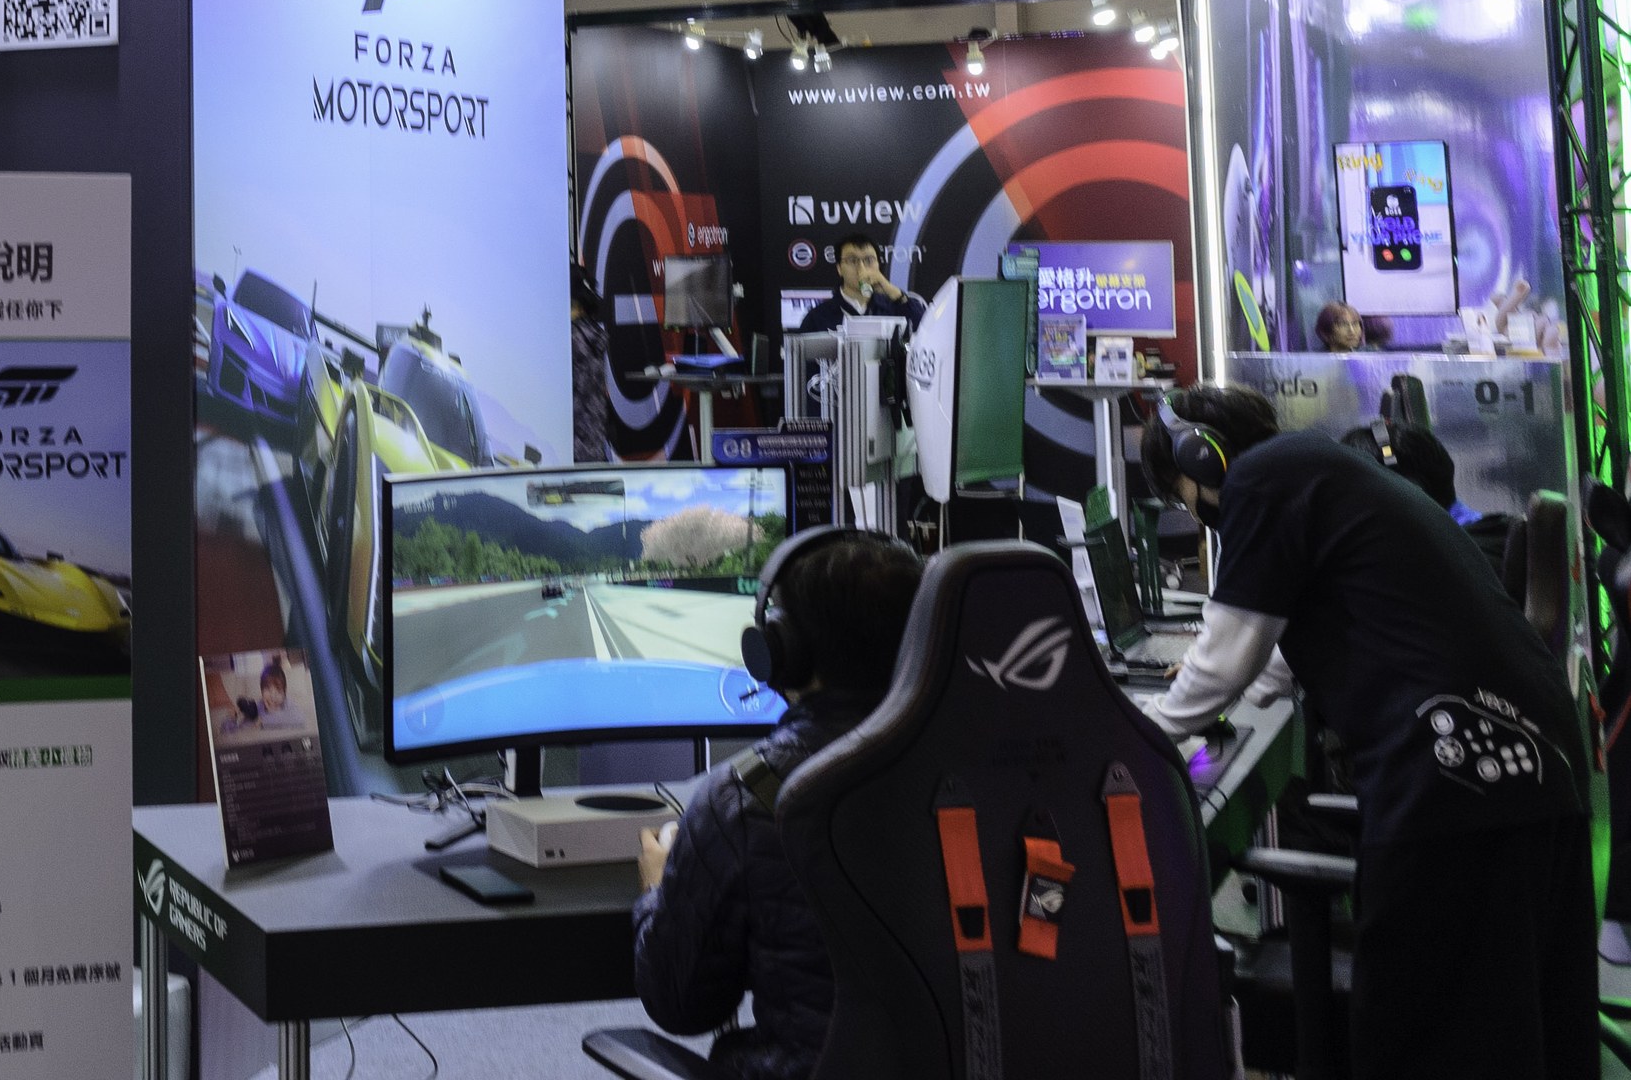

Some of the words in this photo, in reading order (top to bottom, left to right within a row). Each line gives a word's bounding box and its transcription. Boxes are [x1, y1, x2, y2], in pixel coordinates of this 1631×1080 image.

[354, 29, 457, 78] FORZA
[312, 72, 489, 141] MOTORSPORT
[788, 81, 991, 106] www.uview.com.tw
[820, 194, 924, 225] uview
[9, 968, 17, 986] 1
